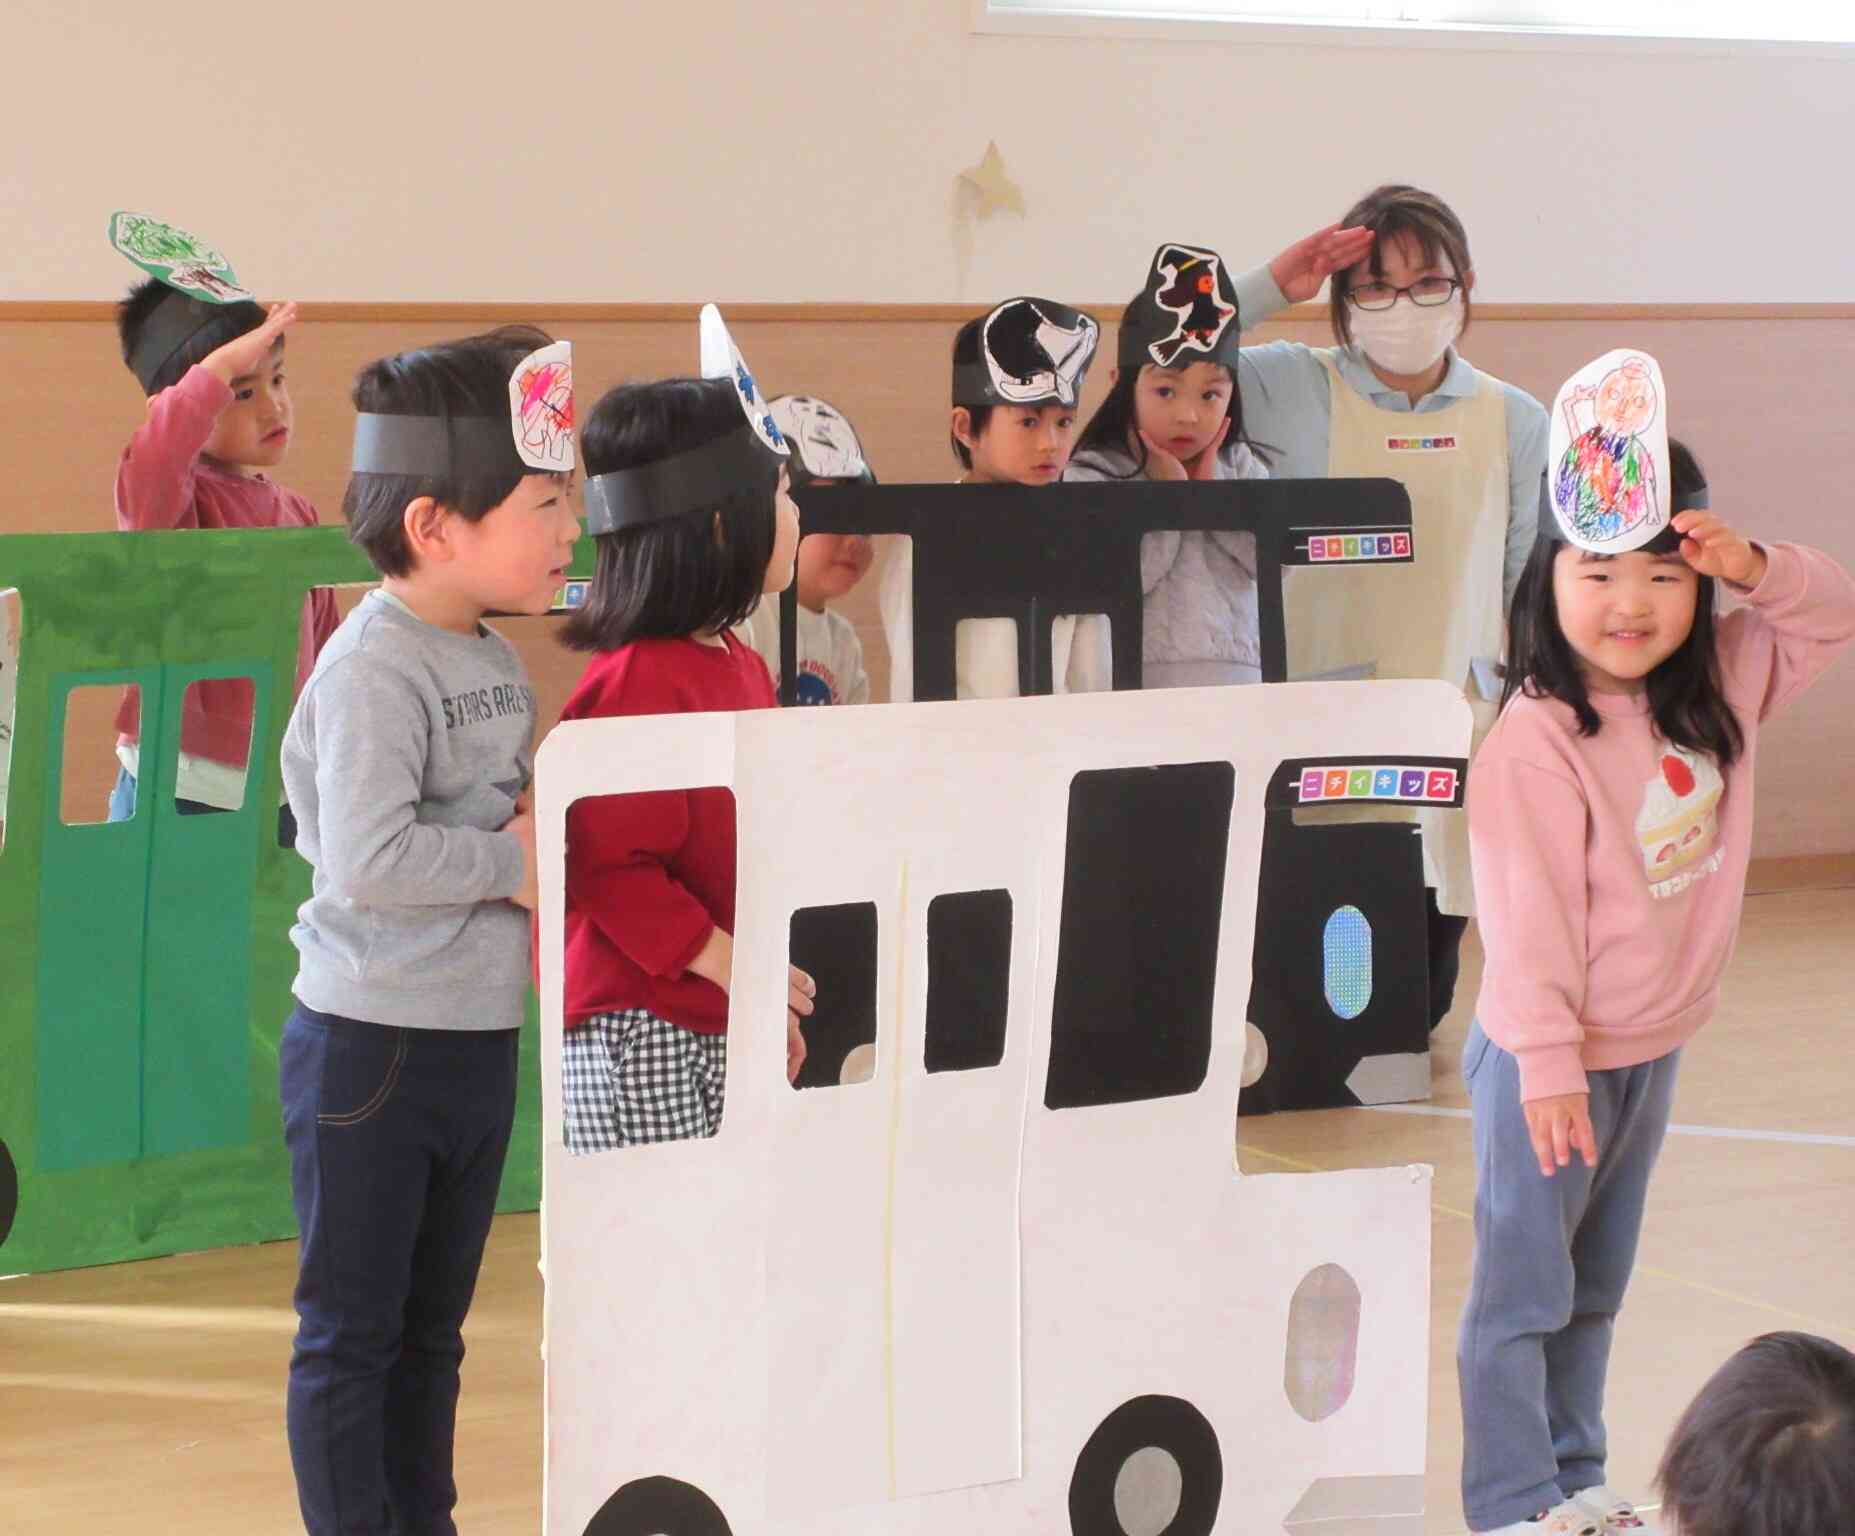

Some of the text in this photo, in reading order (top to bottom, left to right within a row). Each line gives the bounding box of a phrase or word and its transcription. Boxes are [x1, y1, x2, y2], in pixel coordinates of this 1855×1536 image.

[1302, 771, 1453, 797] ニチイキッズ
